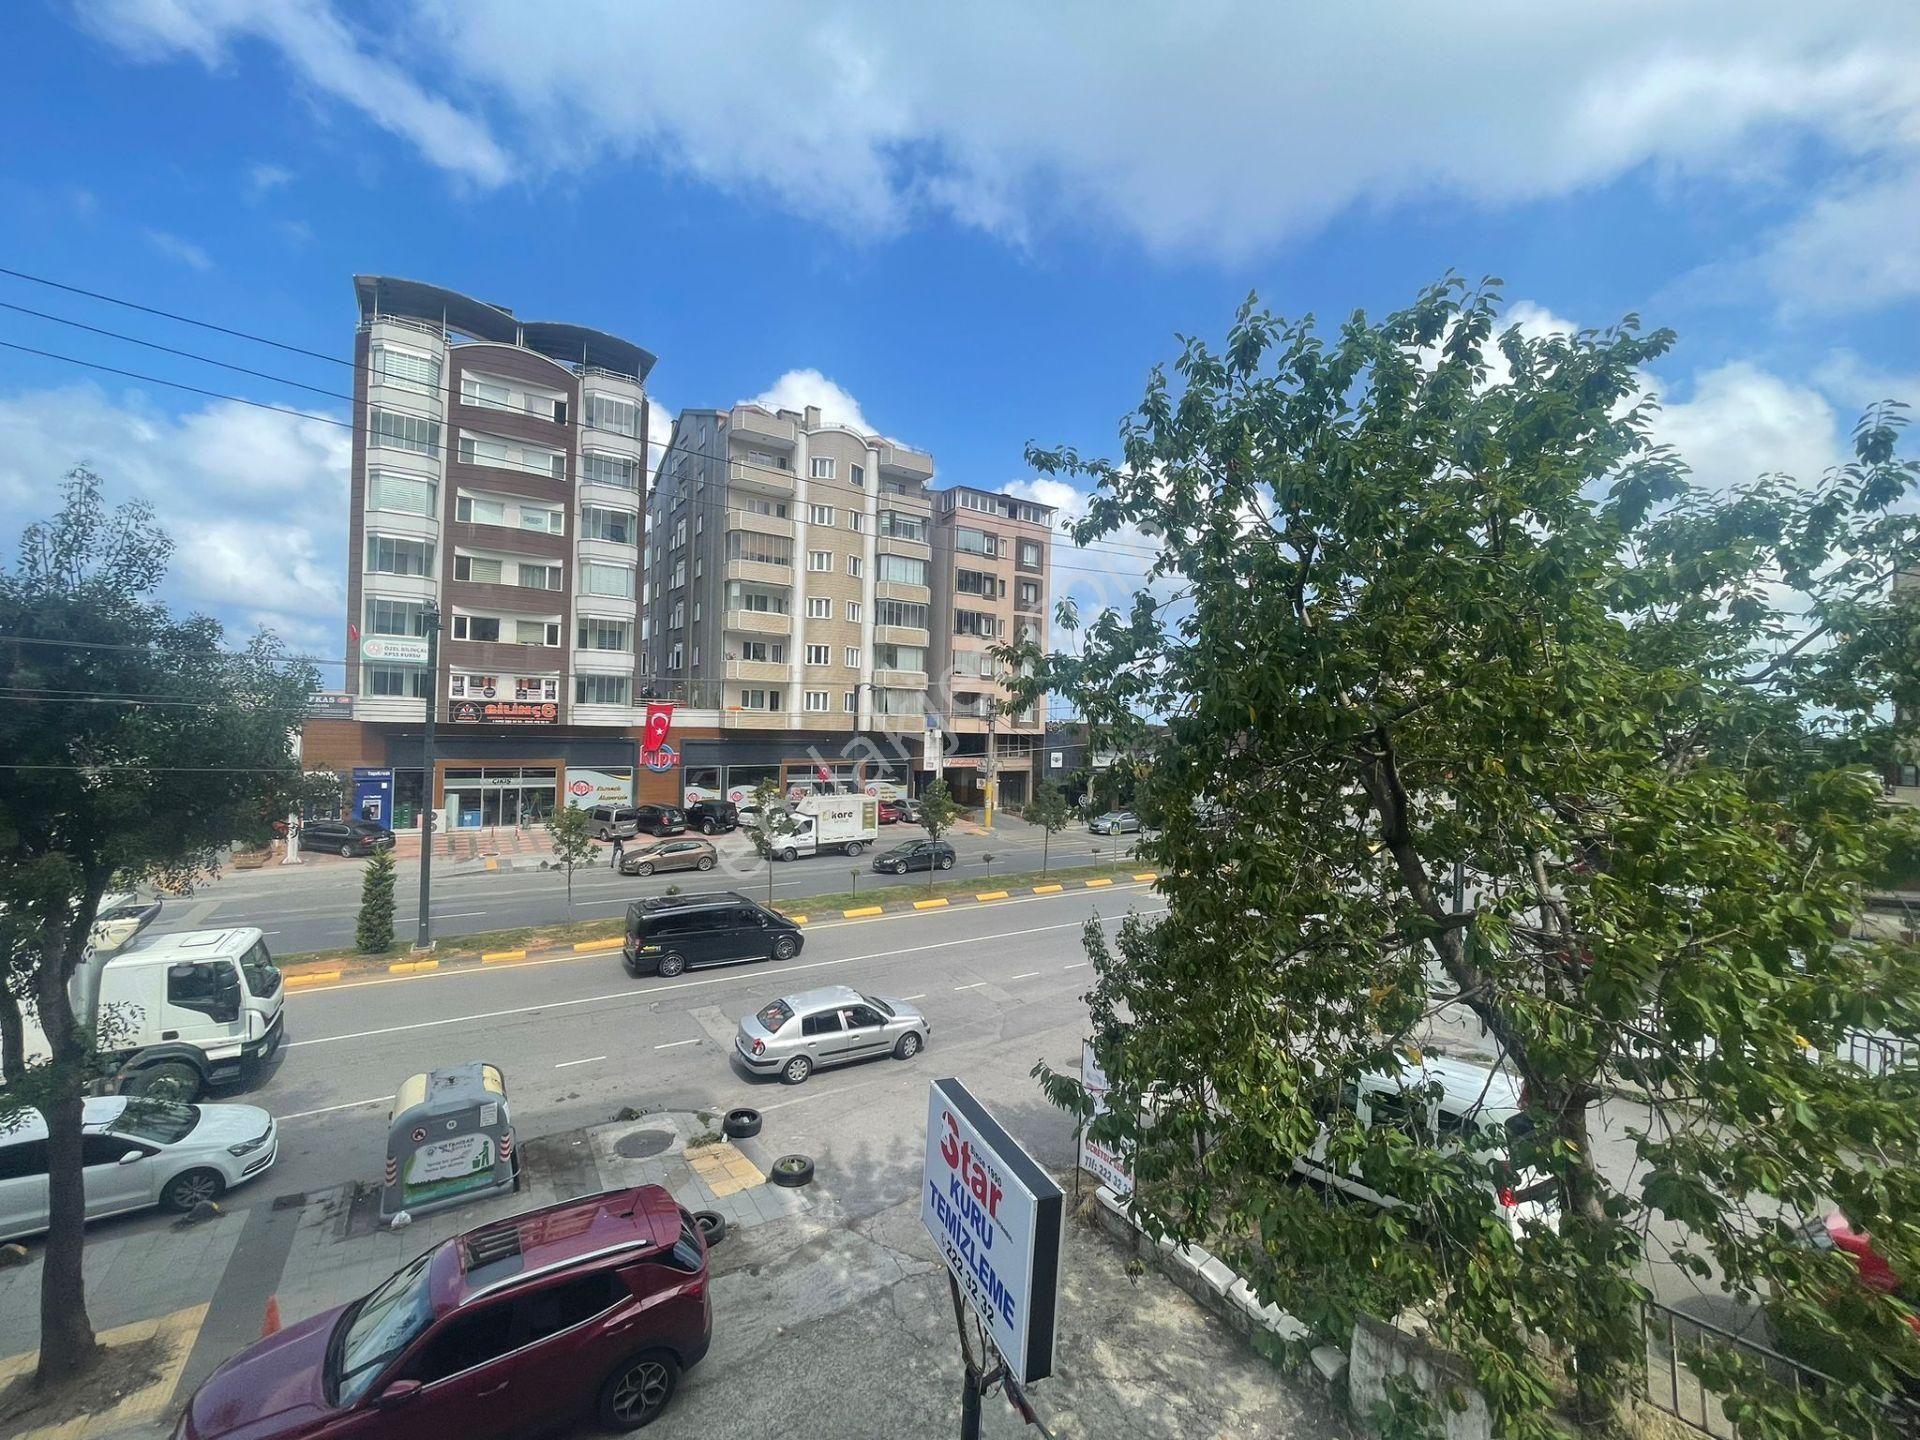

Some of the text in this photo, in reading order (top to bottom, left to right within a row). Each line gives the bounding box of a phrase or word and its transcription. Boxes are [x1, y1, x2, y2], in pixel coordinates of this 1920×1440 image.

[305, 695, 335, 703] FKAS
[940, 1110, 1004, 1218] Star
[1098, 1164, 1112, 1181] 222
[950, 1172, 994, 1250] KURU
[929, 1179, 1016, 1331] TEMİZLEME
[946, 1240, 994, 1328] 222 32 32
